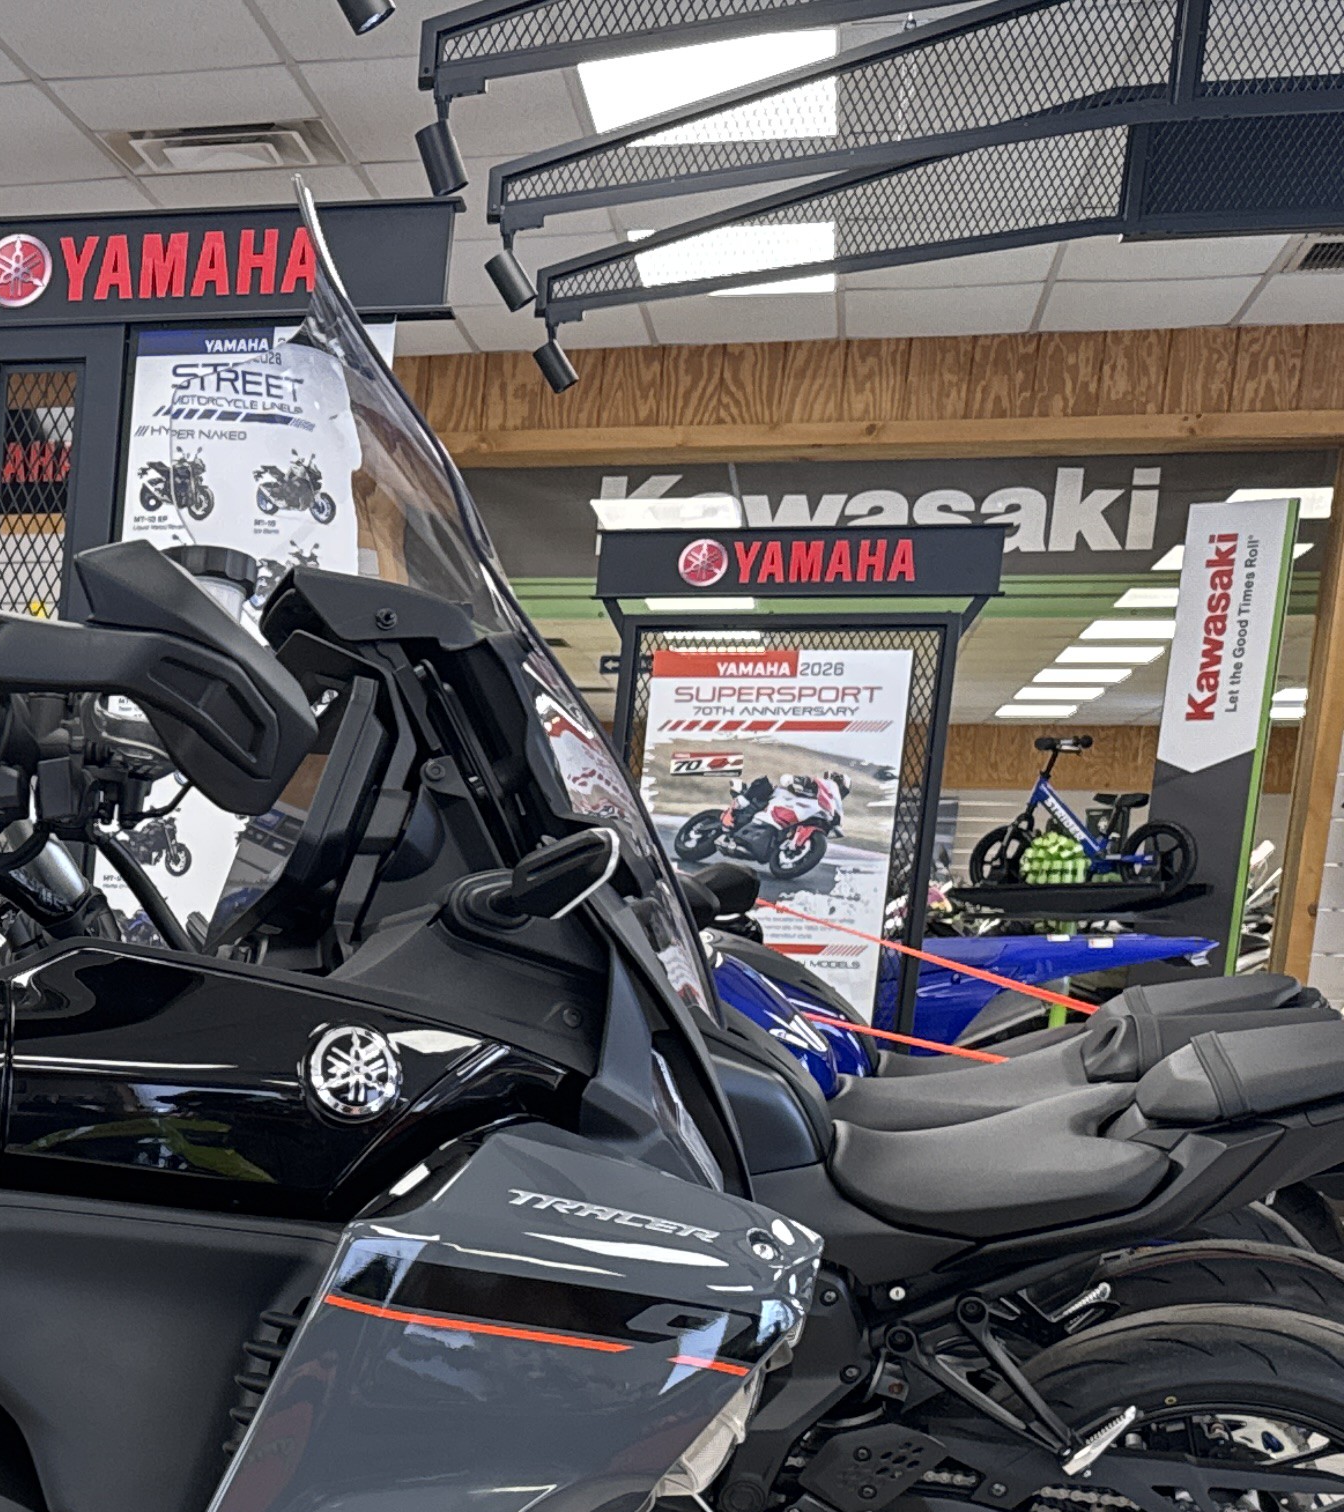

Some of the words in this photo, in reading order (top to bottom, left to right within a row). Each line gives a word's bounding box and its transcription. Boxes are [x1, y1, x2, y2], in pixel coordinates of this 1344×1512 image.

[60, 227, 315, 301] YAMAHA
[205, 338, 270, 354] YAMAHA
[171, 362, 305, 403] STREET
[198, 428, 248, 442] NAKED
[2, 440, 71, 484] AHA
[597, 466, 1162, 556] Kwasaki
[734, 538, 917, 584] YAMAHA
[1237, 571, 1255, 616] Times
[1185, 532, 1239, 722] Kawasaki
[1233, 620, 1249, 659] Good
[717, 661, 791, 677] YAMAHA
[799, 662, 845, 677] 2026
[1229, 662, 1243, 685] the
[674, 686, 884, 704] SUPERSPORT
[692, 706, 734, 717] 70TH
[739, 706, 860, 717] ANNIVERSARY
[1225, 689, 1240, 713] Let
[674, 760, 703, 776] 70
[508, 1189, 720, 1243] TRACER
